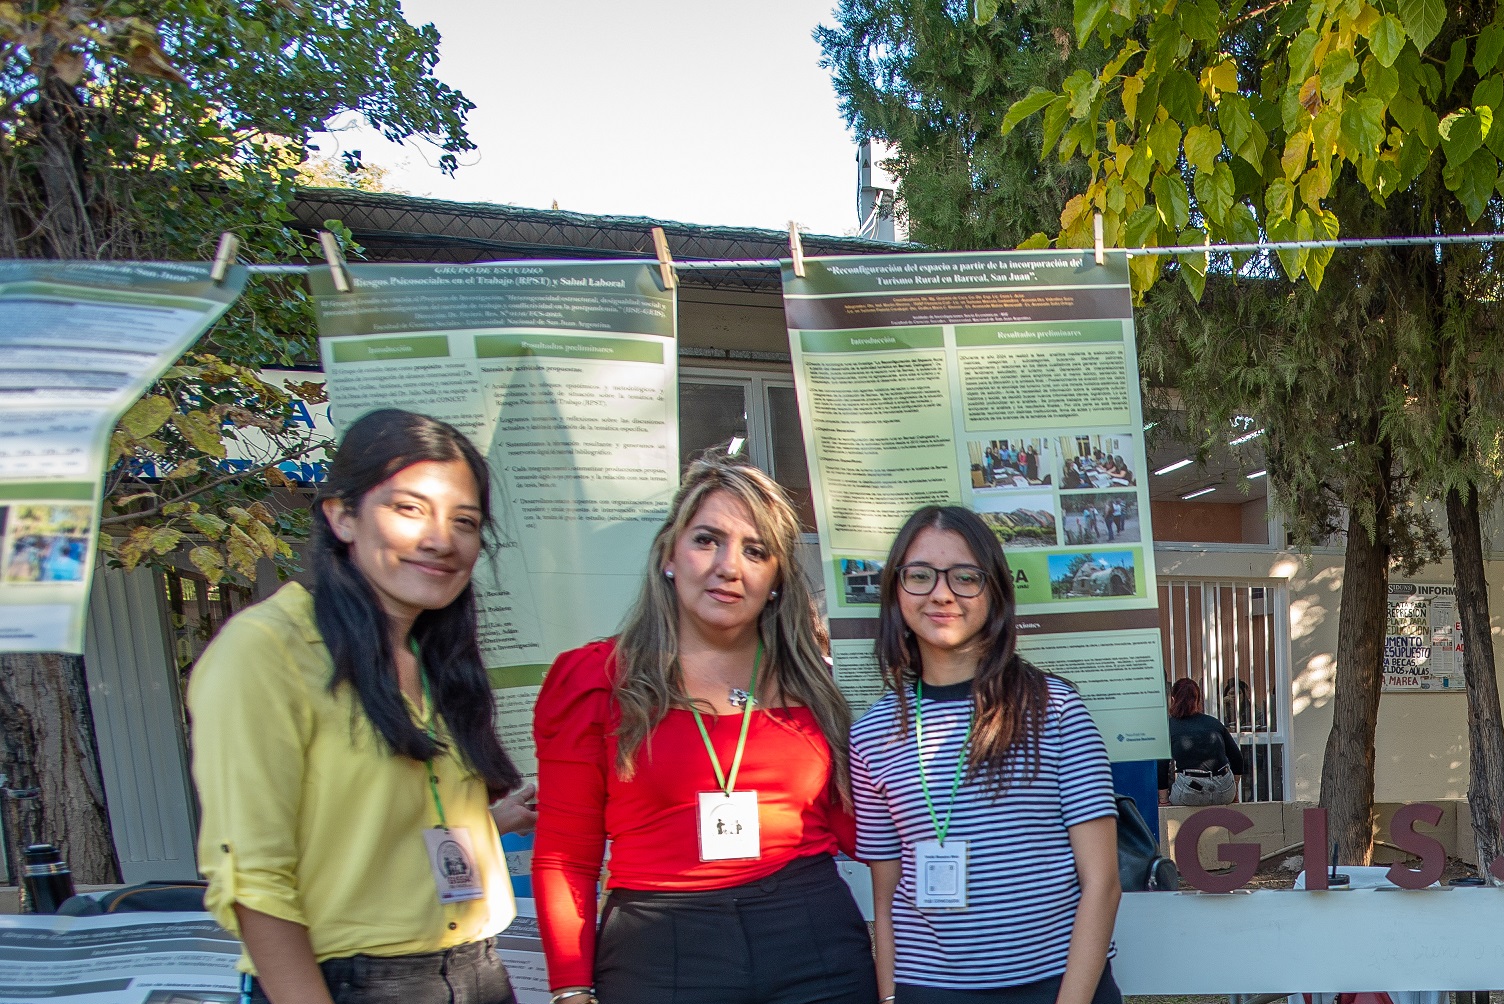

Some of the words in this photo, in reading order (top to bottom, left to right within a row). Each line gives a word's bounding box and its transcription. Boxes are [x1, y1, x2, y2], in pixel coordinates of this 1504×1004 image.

[907, 263, 917, 272] del
[919, 263, 950, 273] espacio
[960, 261, 985, 272] partir
[987, 261, 997, 270] de
[999, 260, 1007, 269] la
[1009, 258, 1068, 270] incorporación
[1070, 258, 1083, 267] del
[390, 277, 449, 286] Psicosociales
[476, 277, 513, 287] Trabajo
[515, 277, 550, 287] (RPST)
[552, 280, 558, 288] y
[560, 277, 587, 286] Salud
[589, 278, 625, 288] Laboral
[876, 275, 913, 286] Turismo
[915, 274, 940, 284] Rural
[942, 275, 952, 283] en
[990, 272, 1006, 282] San
[997, 330, 1035, 340] Resultados
[1037, 329, 1081, 338] preliminares
[850, 336, 896, 345] Introducción
[565, 344, 614, 353] preliminares
[1385, 637, 1422, 646] UMENTO
[1384, 648, 1430, 658] ESUPUESTO
